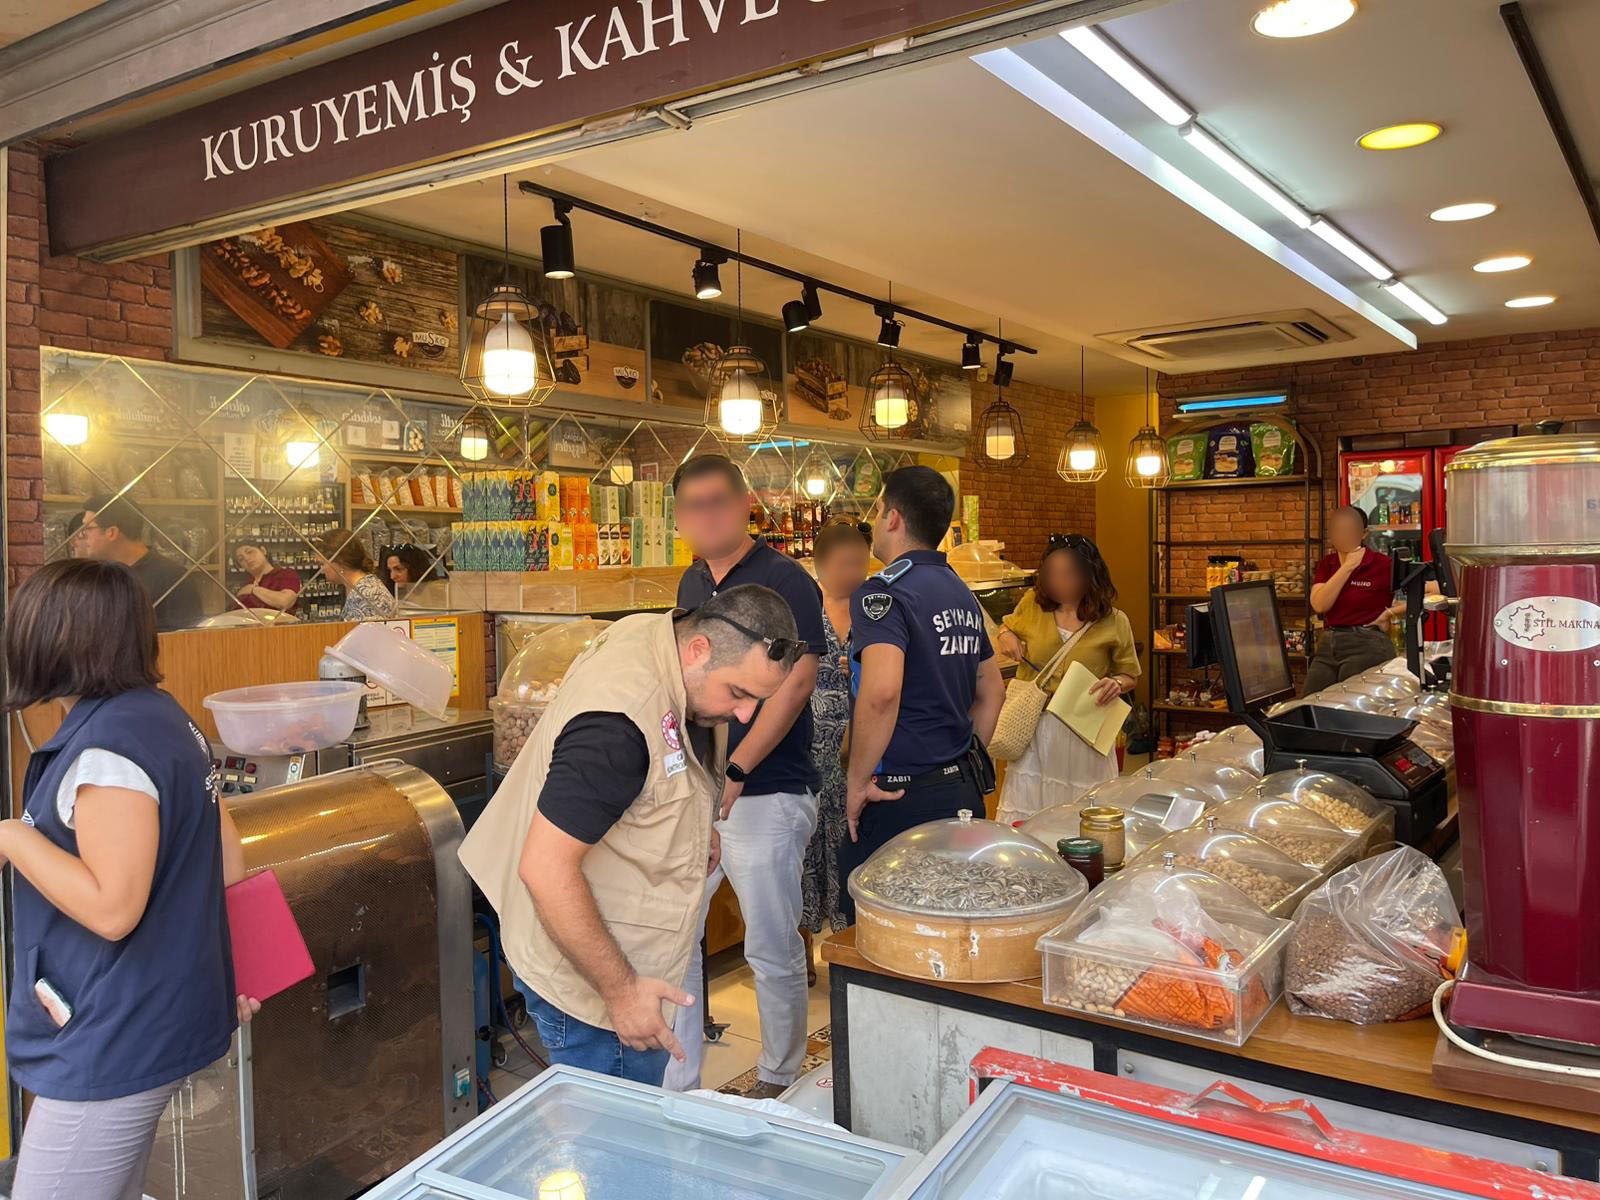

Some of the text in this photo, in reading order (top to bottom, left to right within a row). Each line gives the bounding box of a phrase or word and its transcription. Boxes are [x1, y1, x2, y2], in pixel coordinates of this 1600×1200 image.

[201, 51, 476, 181] KURUYEMİŞ
[495, 40, 543, 96] &
[933, 608, 982, 633] SEYHAN
